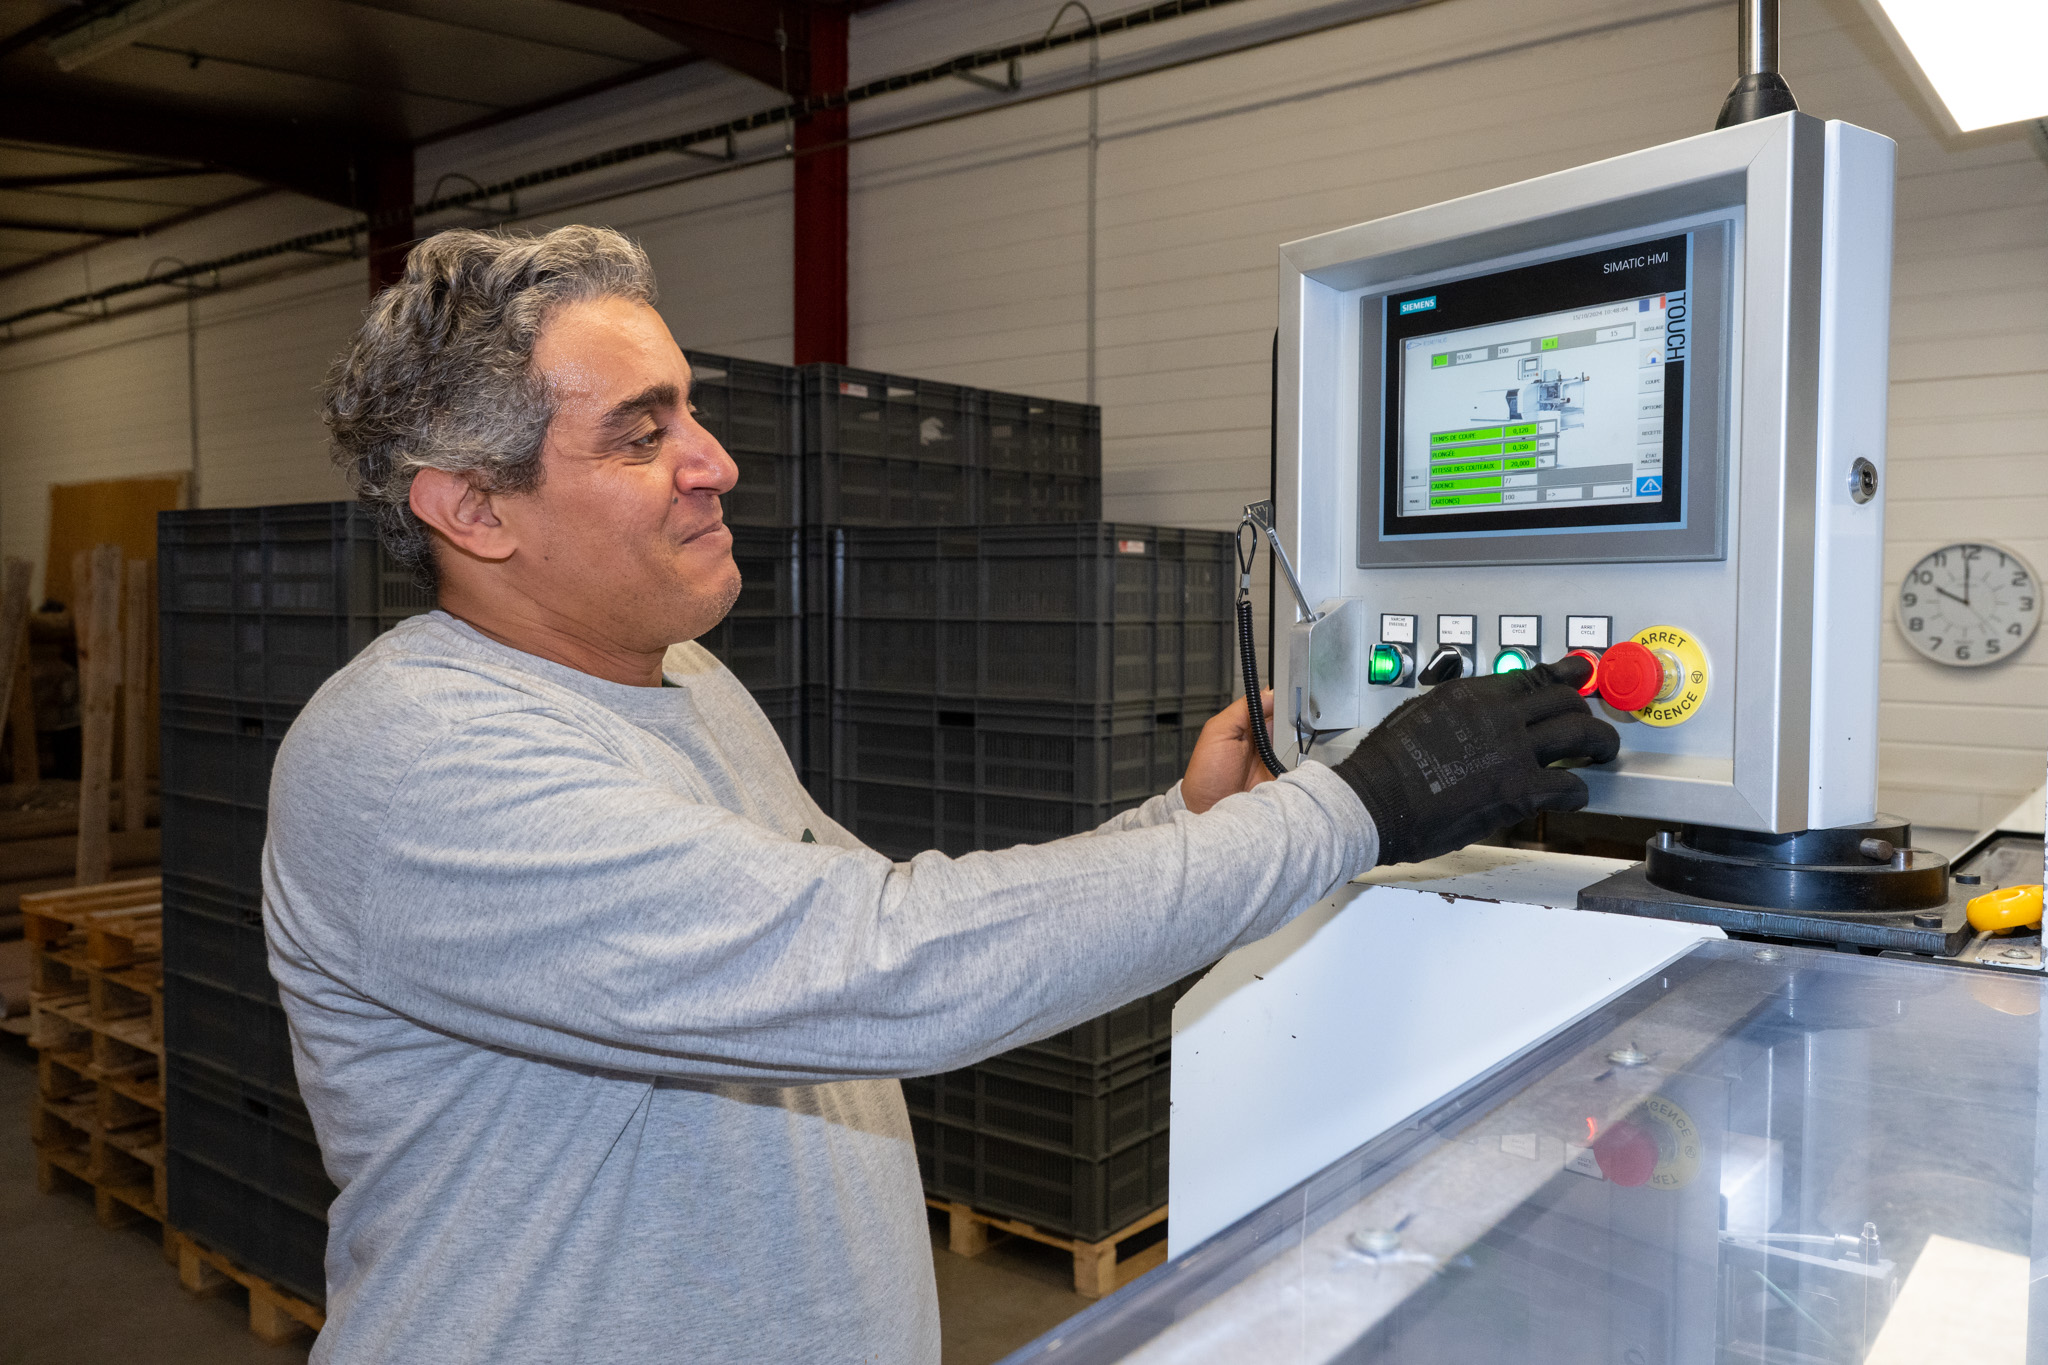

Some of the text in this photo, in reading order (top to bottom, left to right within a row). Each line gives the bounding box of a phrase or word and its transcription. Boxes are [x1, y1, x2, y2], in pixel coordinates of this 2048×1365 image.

[1603, 252, 1669, 274] SIMATIC HMI
[1401, 299, 1435, 313] SIEMENS
[1666, 292, 1687, 361] TOUCH
[1498, 347, 1509, 355] 100
[1432, 435, 1450, 443] TEMPS
[1458, 432, 1476, 440] COUPE
[1513, 427, 1529, 435] 0,120
[1431, 466, 1453, 474] VITESSE
[1465, 463, 1495, 471] COUTEAUX
[1510, 460, 1530, 468] 20,000
[1431, 482, 1454, 490] CADENCE
[1431, 497, 1460, 506] CARTON(S)
[1933, 551, 1947, 567] 11
[1960, 544, 1982, 560] 12
[1998, 551, 2007, 568] 1
[1912, 569, 1934, 585] 10
[2011, 571, 2028, 587] 2
[1902, 592, 1918, 607] 9
[2019, 596, 2034, 612] 3
[1908, 617, 1924, 632] 8
[2006, 622, 2022, 637] 4
[1641, 631, 1687, 648] ARRET
[1929, 636, 1943, 651] 7
[1985, 638, 2001, 654] 5
[1955, 645, 1971, 660] 6
[1637, 691, 1698, 721] RGENCE
